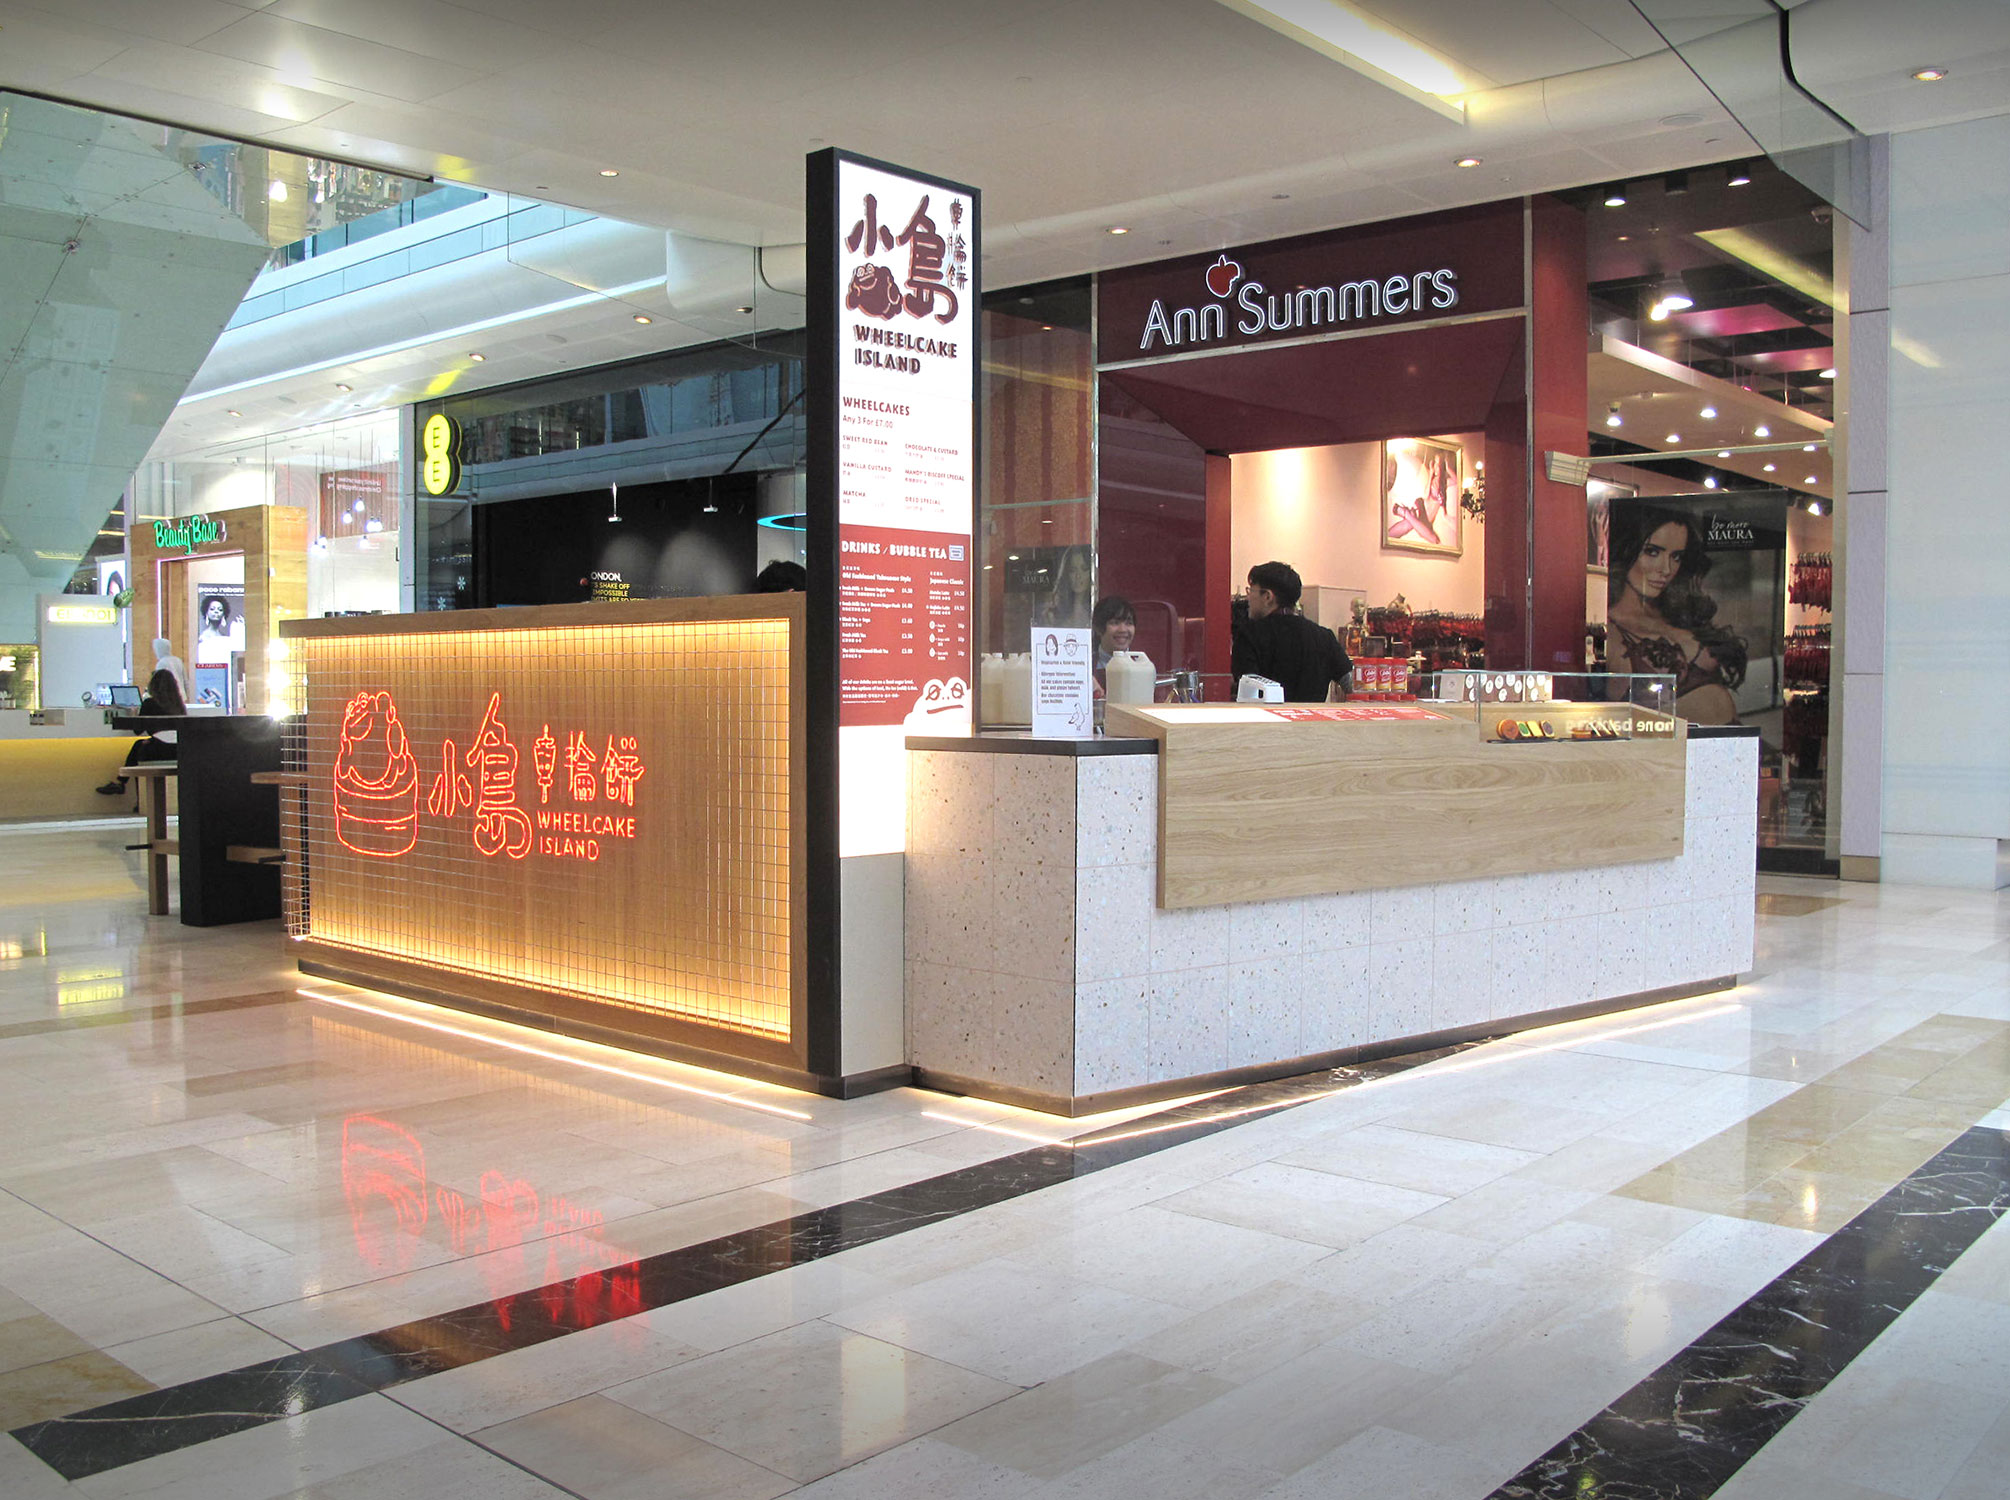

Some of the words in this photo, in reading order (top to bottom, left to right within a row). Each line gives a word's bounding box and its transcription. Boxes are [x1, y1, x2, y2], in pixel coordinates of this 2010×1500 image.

[1139, 300, 1226, 349] Ann
[1238, 269, 1459, 335] Summers
[853, 324, 957, 358] WHEELCAKE
[855, 348, 920, 375] ISLAND
[843, 396, 911, 416] WHEELCAKES
[843, 415, 856, 425] Any
[857, 416, 862, 424] 3
[863, 417, 874, 426] For
[905, 443, 933, 453] CHOCOLATE
[938, 448, 959, 456] CUSTARD
[843, 462, 866, 470] VANILLA
[868, 465, 892, 473] CUSTARD
[153, 519, 192, 556] Beauty
[191, 515, 217, 543] Base
[1707, 529, 1753, 541] MAURA
[841, 541, 881, 555] DRINKS
[889, 544, 927, 558] BUBBLE
[929, 548, 948, 560] TEA
[537, 810, 636, 839] WHEELCAKE
[540, 837, 600, 862] ISLAND
